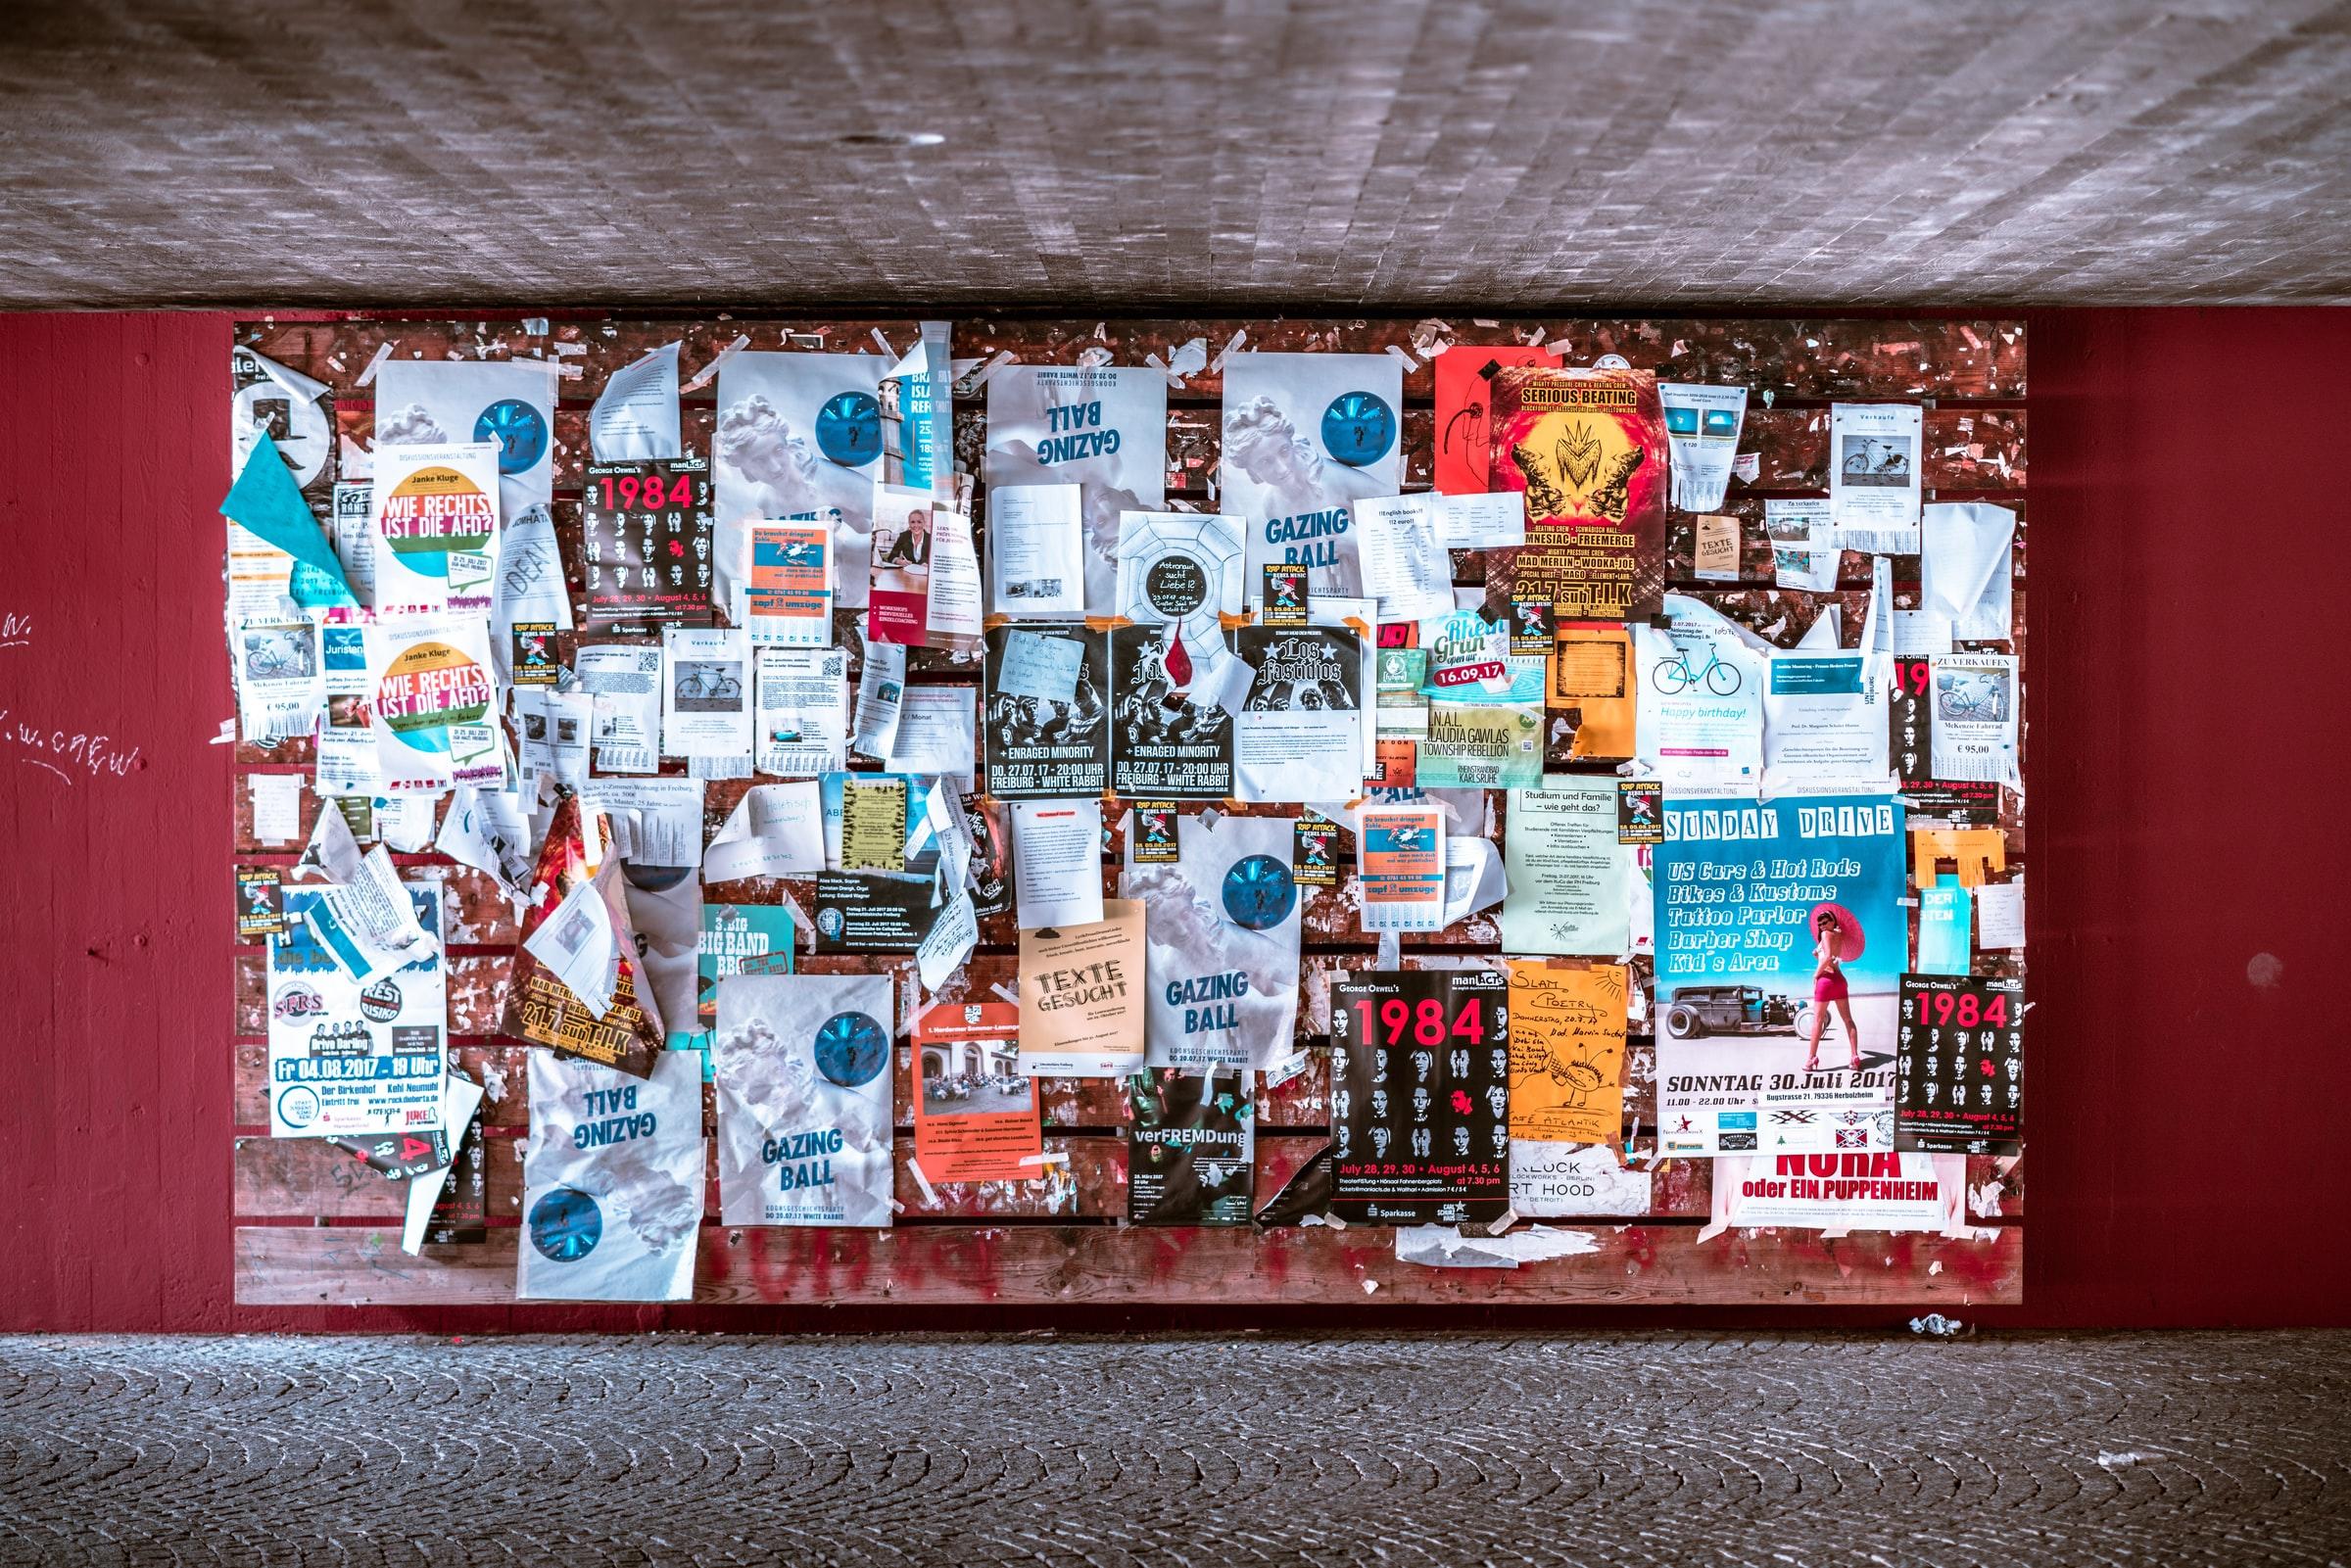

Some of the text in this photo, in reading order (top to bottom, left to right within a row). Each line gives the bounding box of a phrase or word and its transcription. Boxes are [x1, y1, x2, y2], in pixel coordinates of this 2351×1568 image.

[1521, 388, 1637, 407] SERIOUS BEATING
[1046, 401, 1101, 432] BALL
[1037, 429, 1121, 465] GAZING
[411, 473, 458, 484] Janke Kluge
[600, 476, 693, 510] 1984
[384, 493, 489, 517] WIE RECHTS
[384, 515, 494, 539] IST DIE AFD?
[1266, 508, 1349, 544] GAZING
[1525, 533, 1635, 547] MNESIAC FREEMERGE
[1701, 538, 1733, 549] TEXTE
[1701, 546, 1735, 556] GESUCHT
[1517, 555, 1634, 570] MAD MERLIN WODKA-JOE
[1562, 570, 1586, 579] MAGO
[1160, 580, 1185, 589] Liebe
[752, 598, 775, 608] zapf
[1561, 590, 1588, 604] sub
[325, 644, 362, 654] Juristen
[404, 647, 451, 662] Janke Kluge
[381, 663, 484, 698] WIE RECHTS
[1440, 665, 1500, 684] 16.09.17
[381, 688, 489, 719] IST DIE AFD?
[1661, 707, 1746, 721] Happy birthday!
[1467, 729, 1510, 744] GAWLAS
[1008, 745, 1095, 760] ENRAGED MINORITY
[1423, 742, 1510, 756] TOWNSHIP REBELLION
[1965, 745, 1989, 754] 95,00
[991, 763, 1104, 777] DO. 27.07.17 20:00 UHR
[1458, 765, 1500, 775] RHEINSTRANDBAD
[1459, 773, 1498, 784] KARLSRUHE
[991, 775, 1105, 789] FREIBURG WHITE RABBIT
[1635, 783, 1659, 791] ATTACK
[1664, 805, 1895, 841] SUNDAY DRIVE
[1667, 858, 1860, 880] US Cars Hot Rods
[1667, 883, 1836, 903] Bikes Kustoms
[1668, 906, 1806, 927] Tattoo Parlor
[726, 934, 769, 954] BAND
[1669, 929, 1793, 951] Barber Shop
[1728, 954, 1779, 972] Area
[1034, 960, 1124, 994] TEXTE
[1511, 971, 1559, 989] SLAM
[1037, 981, 1128, 1012] GESUCHT
[1166, 971, 1249, 1006] GAZING
[1339, 984, 1367, 993] GEORGE
[1537, 992, 1597, 1019] POETRY
[1916, 991, 2007, 1027] 1984
[1184, 1006, 1239, 1034] BALL
[1354, 998, 1484, 1046] 1984
[337, 1039, 367, 1050] Darling
[278, 1057, 438, 1079] Fr 04.08.2017 19 Uhr
[321, 1086, 335, 1096] Der
[338, 1084, 376, 1095] Birkenhof
[388, 1083, 404, 1093] Kehl
[1666, 1070, 1896, 1093] SONNTAG 30.Juli 2017
[584, 1085, 637, 1117] BALL
[1666, 1098, 1689, 1107] 11.00
[1727, 1097, 1746, 1106] Uhr
[1766, 1093, 1801, 1102] Bugstrasse
[1834, 1091, 1873, 1100] Herbolzheim
[574, 1112, 657, 1150] GAZING
[1544, 1117, 1600, 1127] ATLANTIK
[762, 1128, 843, 1164] GAZING
[1135, 1128, 1246, 1147] verFREMDung
[780, 1160, 835, 1191] BALL
[1340, 1164, 1500, 1176] July 28, 29, 30 August 4, 5, 6
[1543, 1184, 1594, 1196] HOOD
[1743, 1179, 1938, 1201] oder EIN PUPPENHEIM
